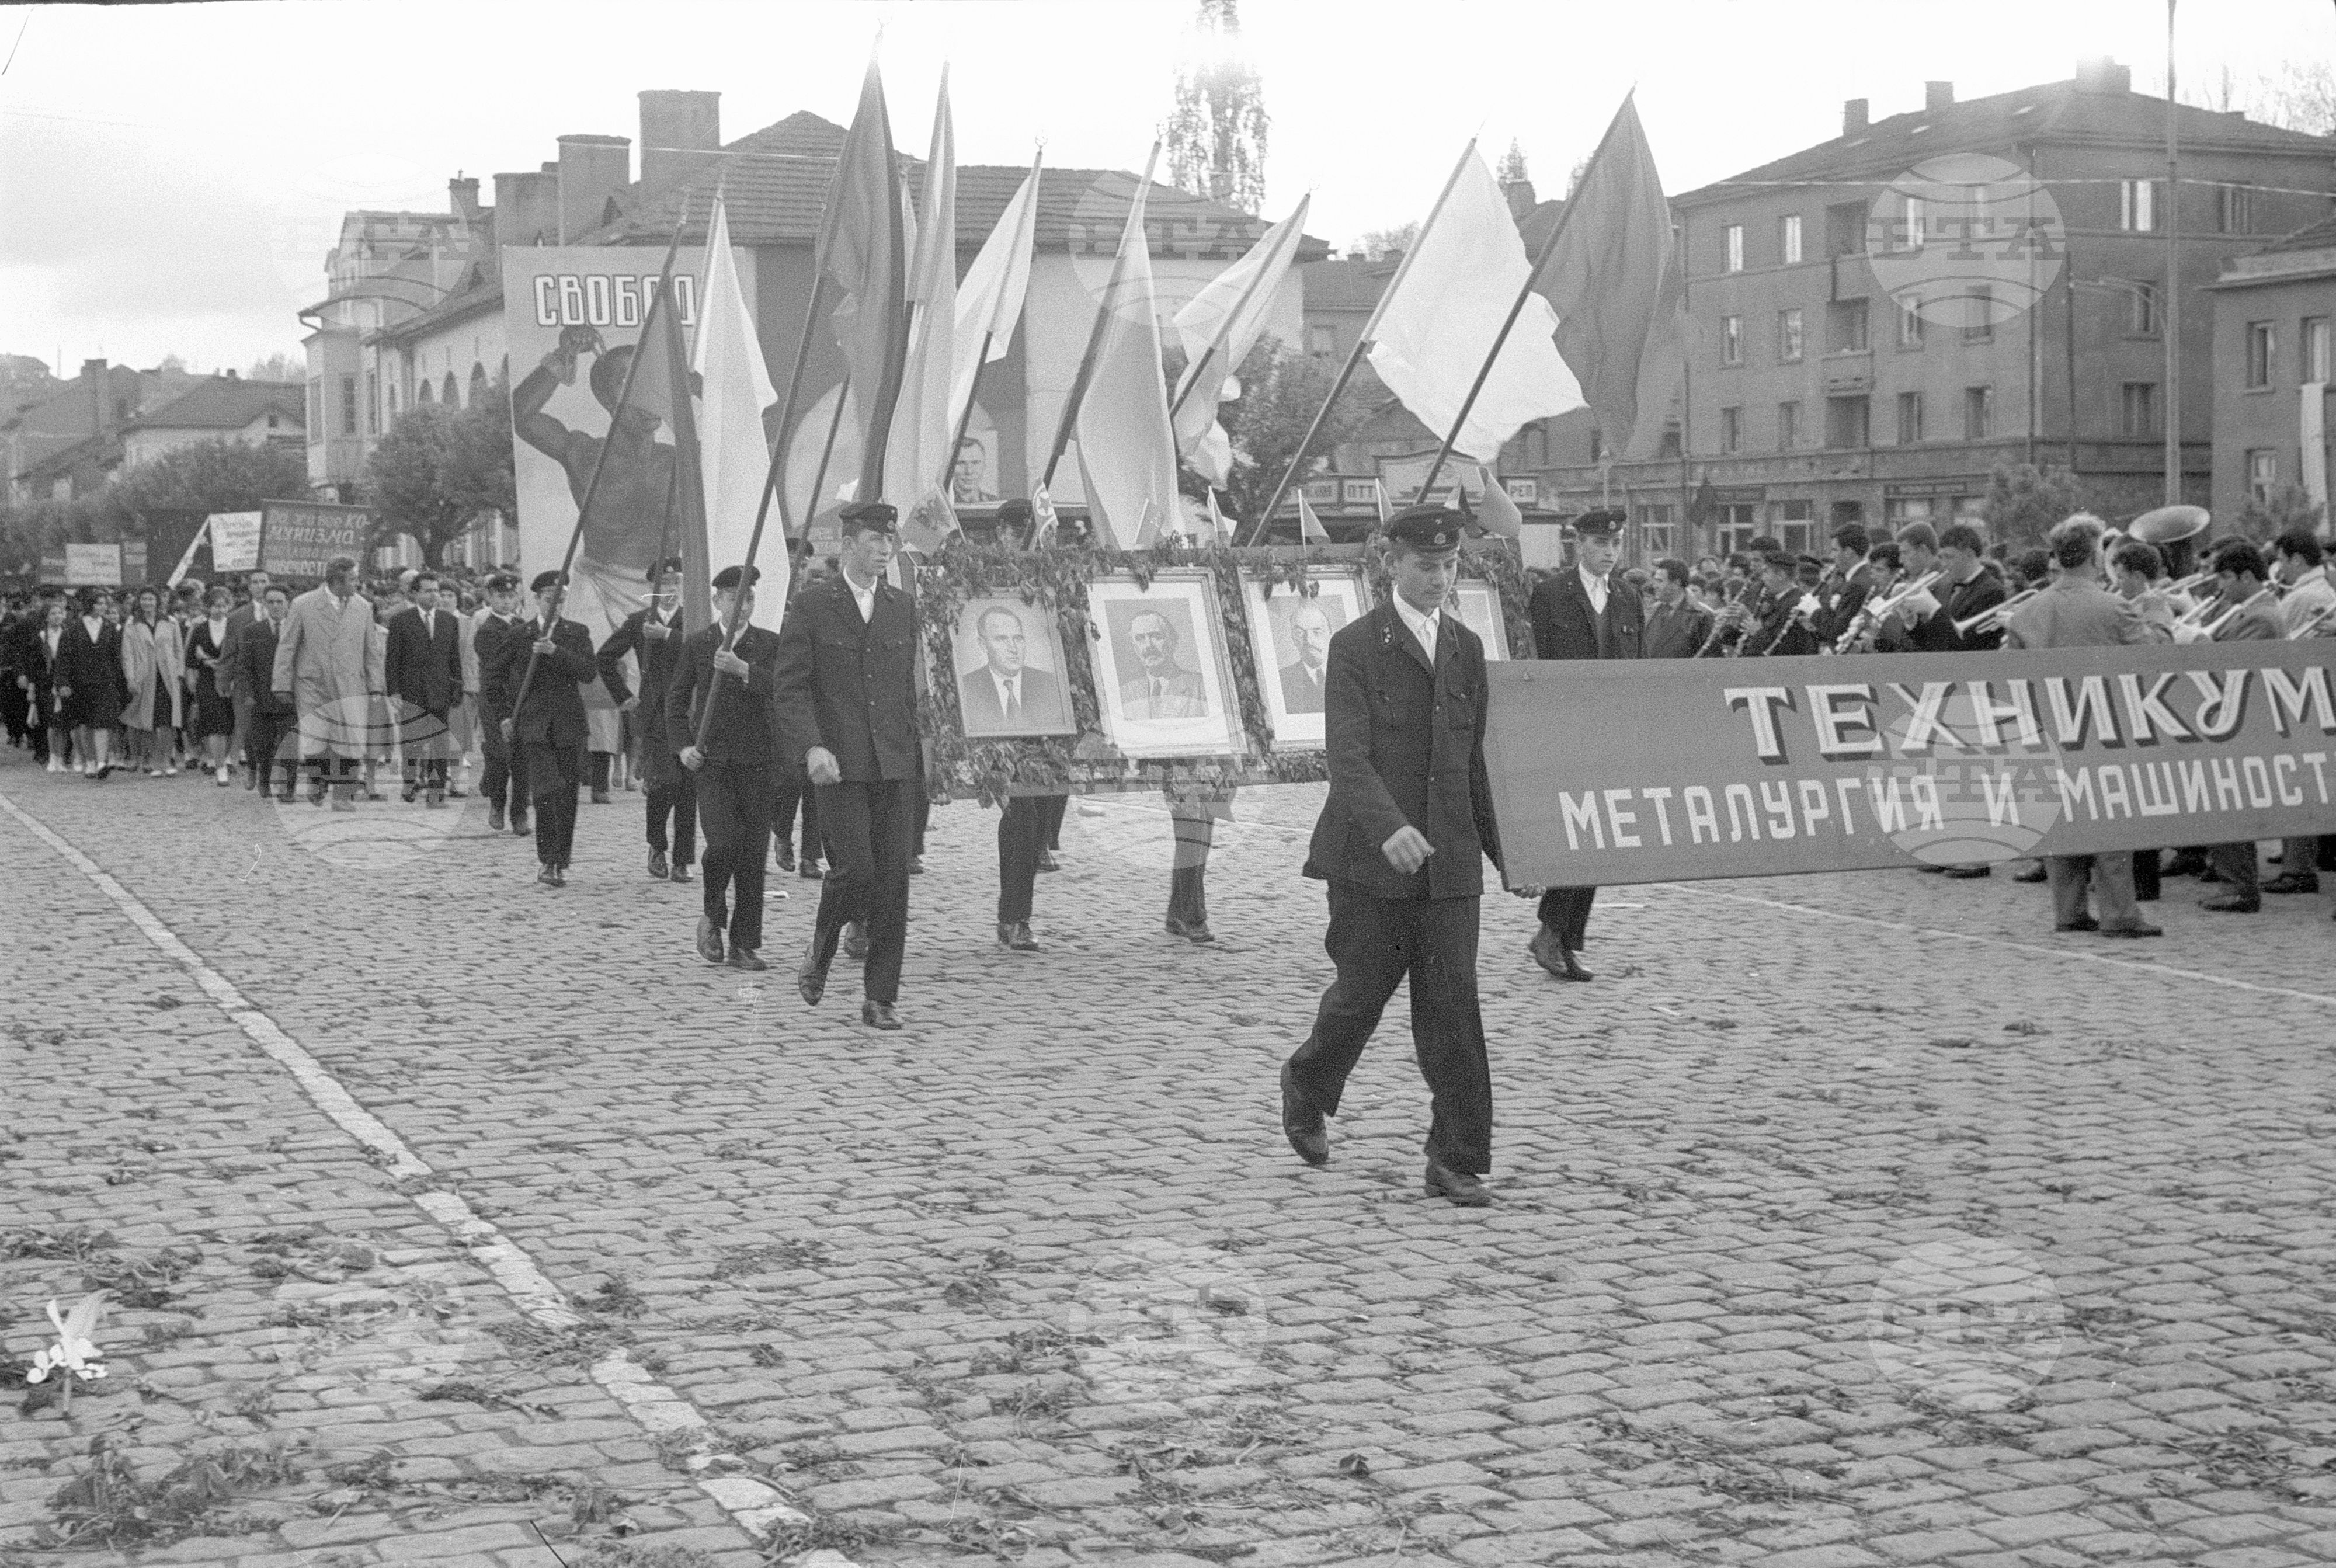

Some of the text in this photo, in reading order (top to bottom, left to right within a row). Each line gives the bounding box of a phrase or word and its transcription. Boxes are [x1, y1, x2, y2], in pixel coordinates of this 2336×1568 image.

[1724, 666, 2336, 759] ТЕХНИКУМ
[1558, 774, 1944, 850] МЕТАЛУРГИЯ
[1980, 771, 2021, 827] И
